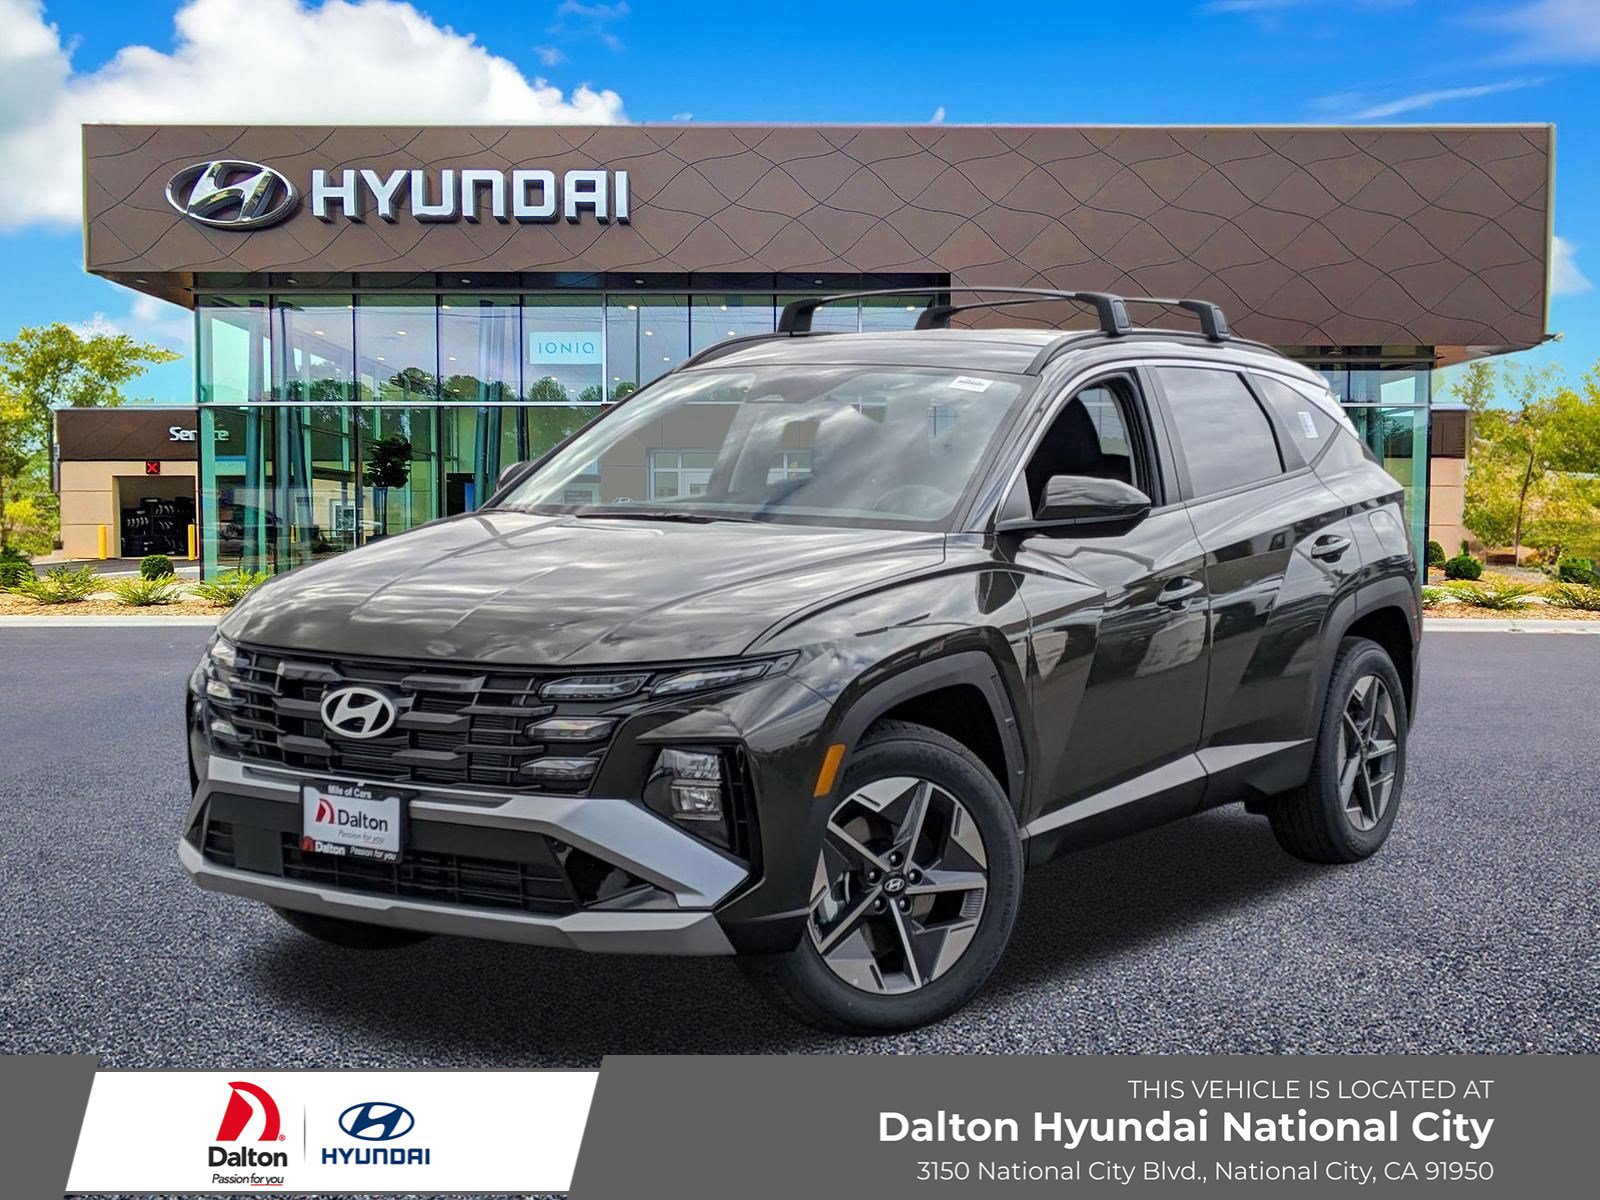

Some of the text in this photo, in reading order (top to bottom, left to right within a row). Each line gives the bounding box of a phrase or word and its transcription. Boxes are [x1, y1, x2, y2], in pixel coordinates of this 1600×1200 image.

[312, 169, 631, 223] HYUNDAI
[328, 784, 372, 799] Mile of Cars
[337, 809, 388, 832] Dalton
[315, 840, 397, 861] Dalton Passion for you
